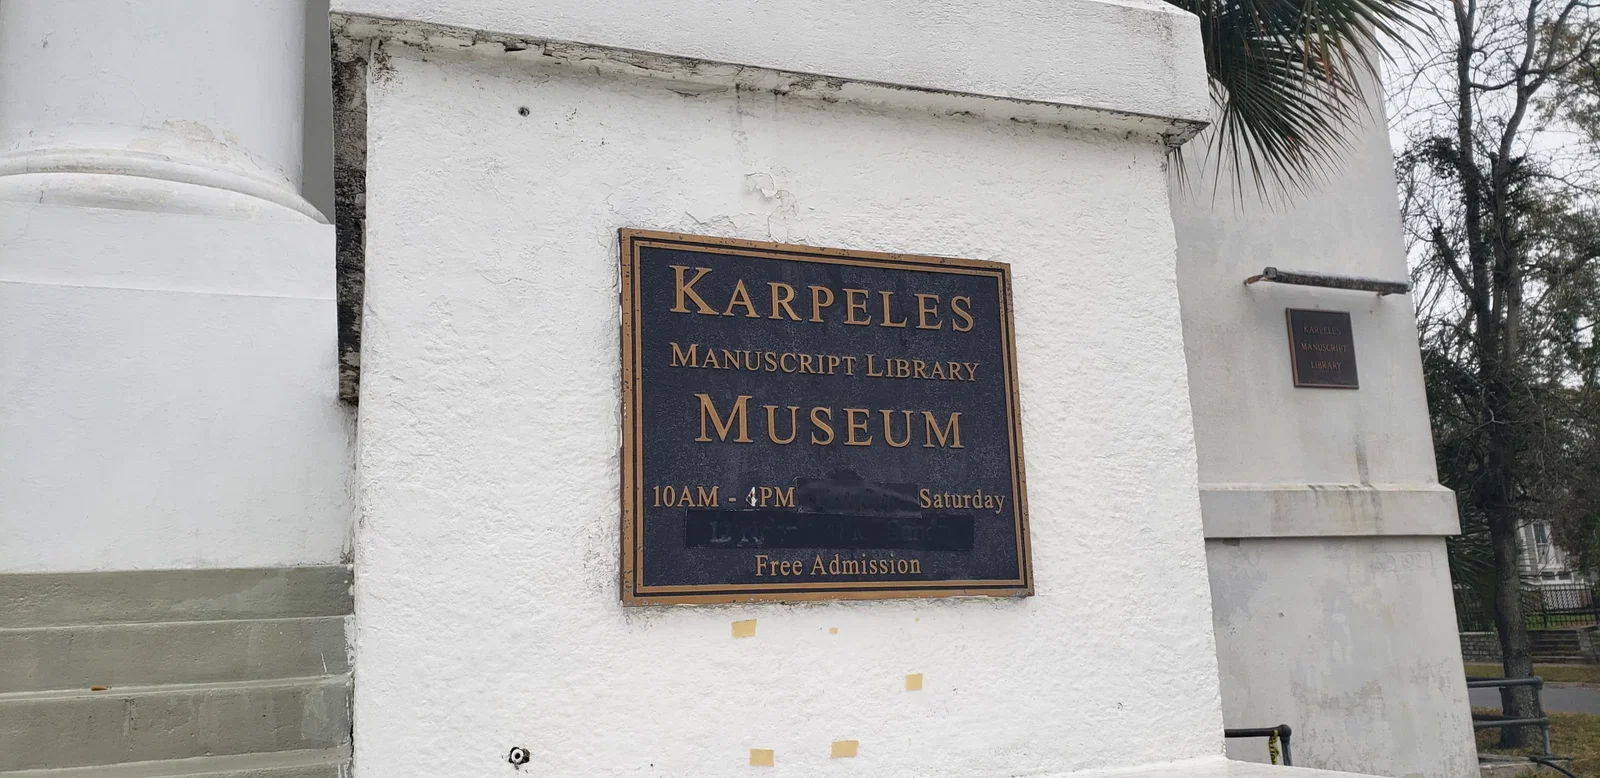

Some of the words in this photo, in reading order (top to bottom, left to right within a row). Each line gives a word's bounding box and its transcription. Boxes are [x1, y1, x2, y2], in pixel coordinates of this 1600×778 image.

[669, 263, 976, 333] KARPELES
[1303, 325, 1341, 335] KARPELES
[1301, 343, 1347, 352] MANUSCRIPT
[669, 341, 857, 376] MANUSCRIPT
[866, 352, 980, 382] LIBRARY
[1310, 361, 1342, 370] LIBRARY
[694, 392, 965, 449] MUSEUM
[653, 485, 720, 508] 10AM
[745, 486, 796, 508] 4PM
[919, 487, 1006, 513] Saturday
[754, 554, 803, 577] Free
[811, 553, 922, 576] Admission
